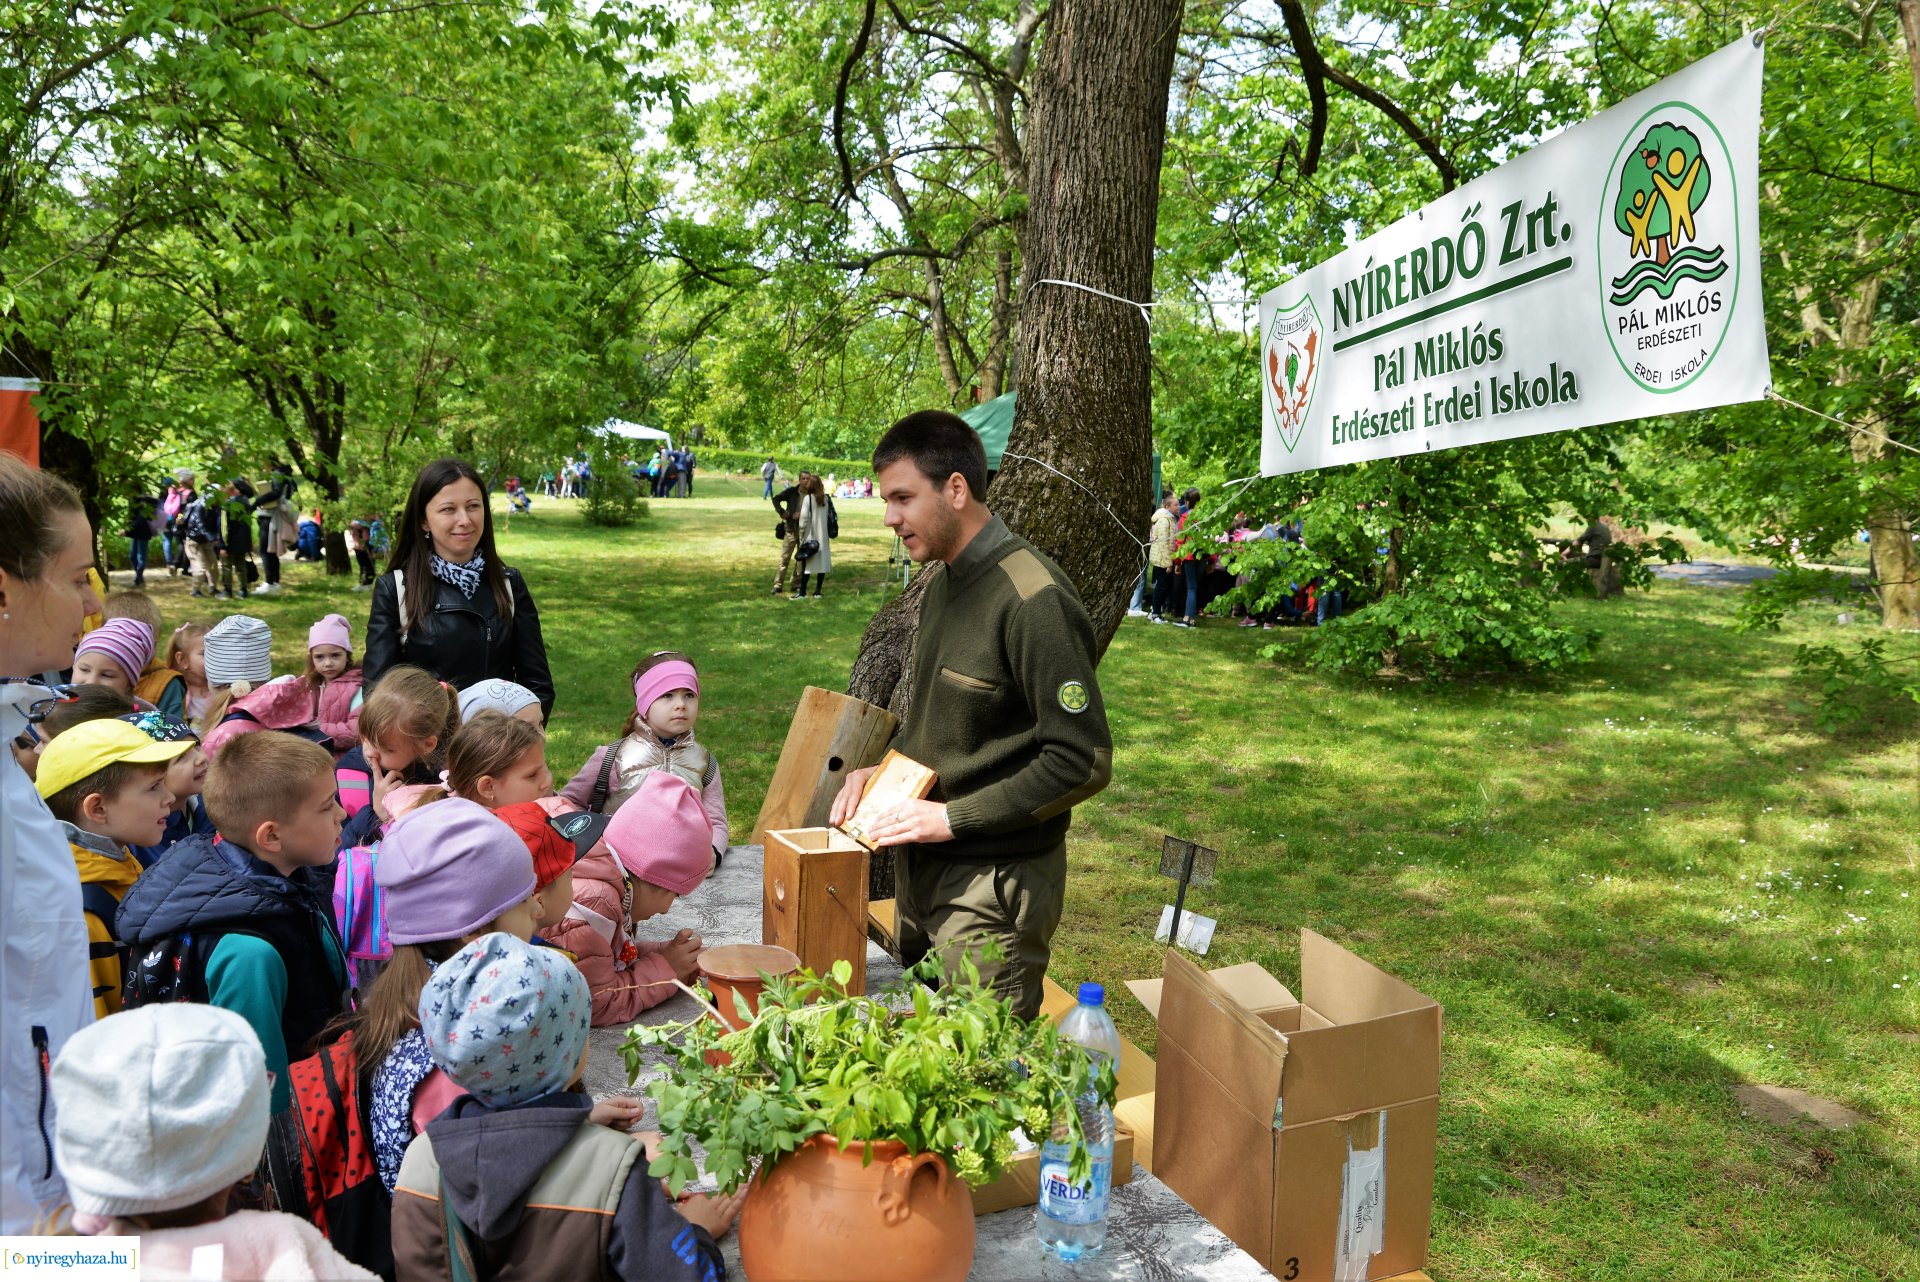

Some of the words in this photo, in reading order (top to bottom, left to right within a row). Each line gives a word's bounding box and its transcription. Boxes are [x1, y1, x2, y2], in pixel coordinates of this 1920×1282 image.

[1332, 200, 1486, 332] NYÍRERDŐ
[1499, 190, 1573, 266] Zrt.
[1618, 308, 1649, 335] PÁL
[1655, 289, 1722, 326] MIKLÓS
[1373, 346, 1405, 392] Pál
[1414, 320, 1505, 382] Miklós
[1637, 322, 1702, 350] ERDÉSZETI
[1634, 361, 1662, 384] ERDEI
[1670, 348, 1708, 382] ISKOLA
[1332, 395, 1415, 446] Erdészeti
[1423, 379, 1483, 428] Erdei
[1489, 361, 1580, 416] Iskola
[1284, 1256, 1300, 1281] 3
